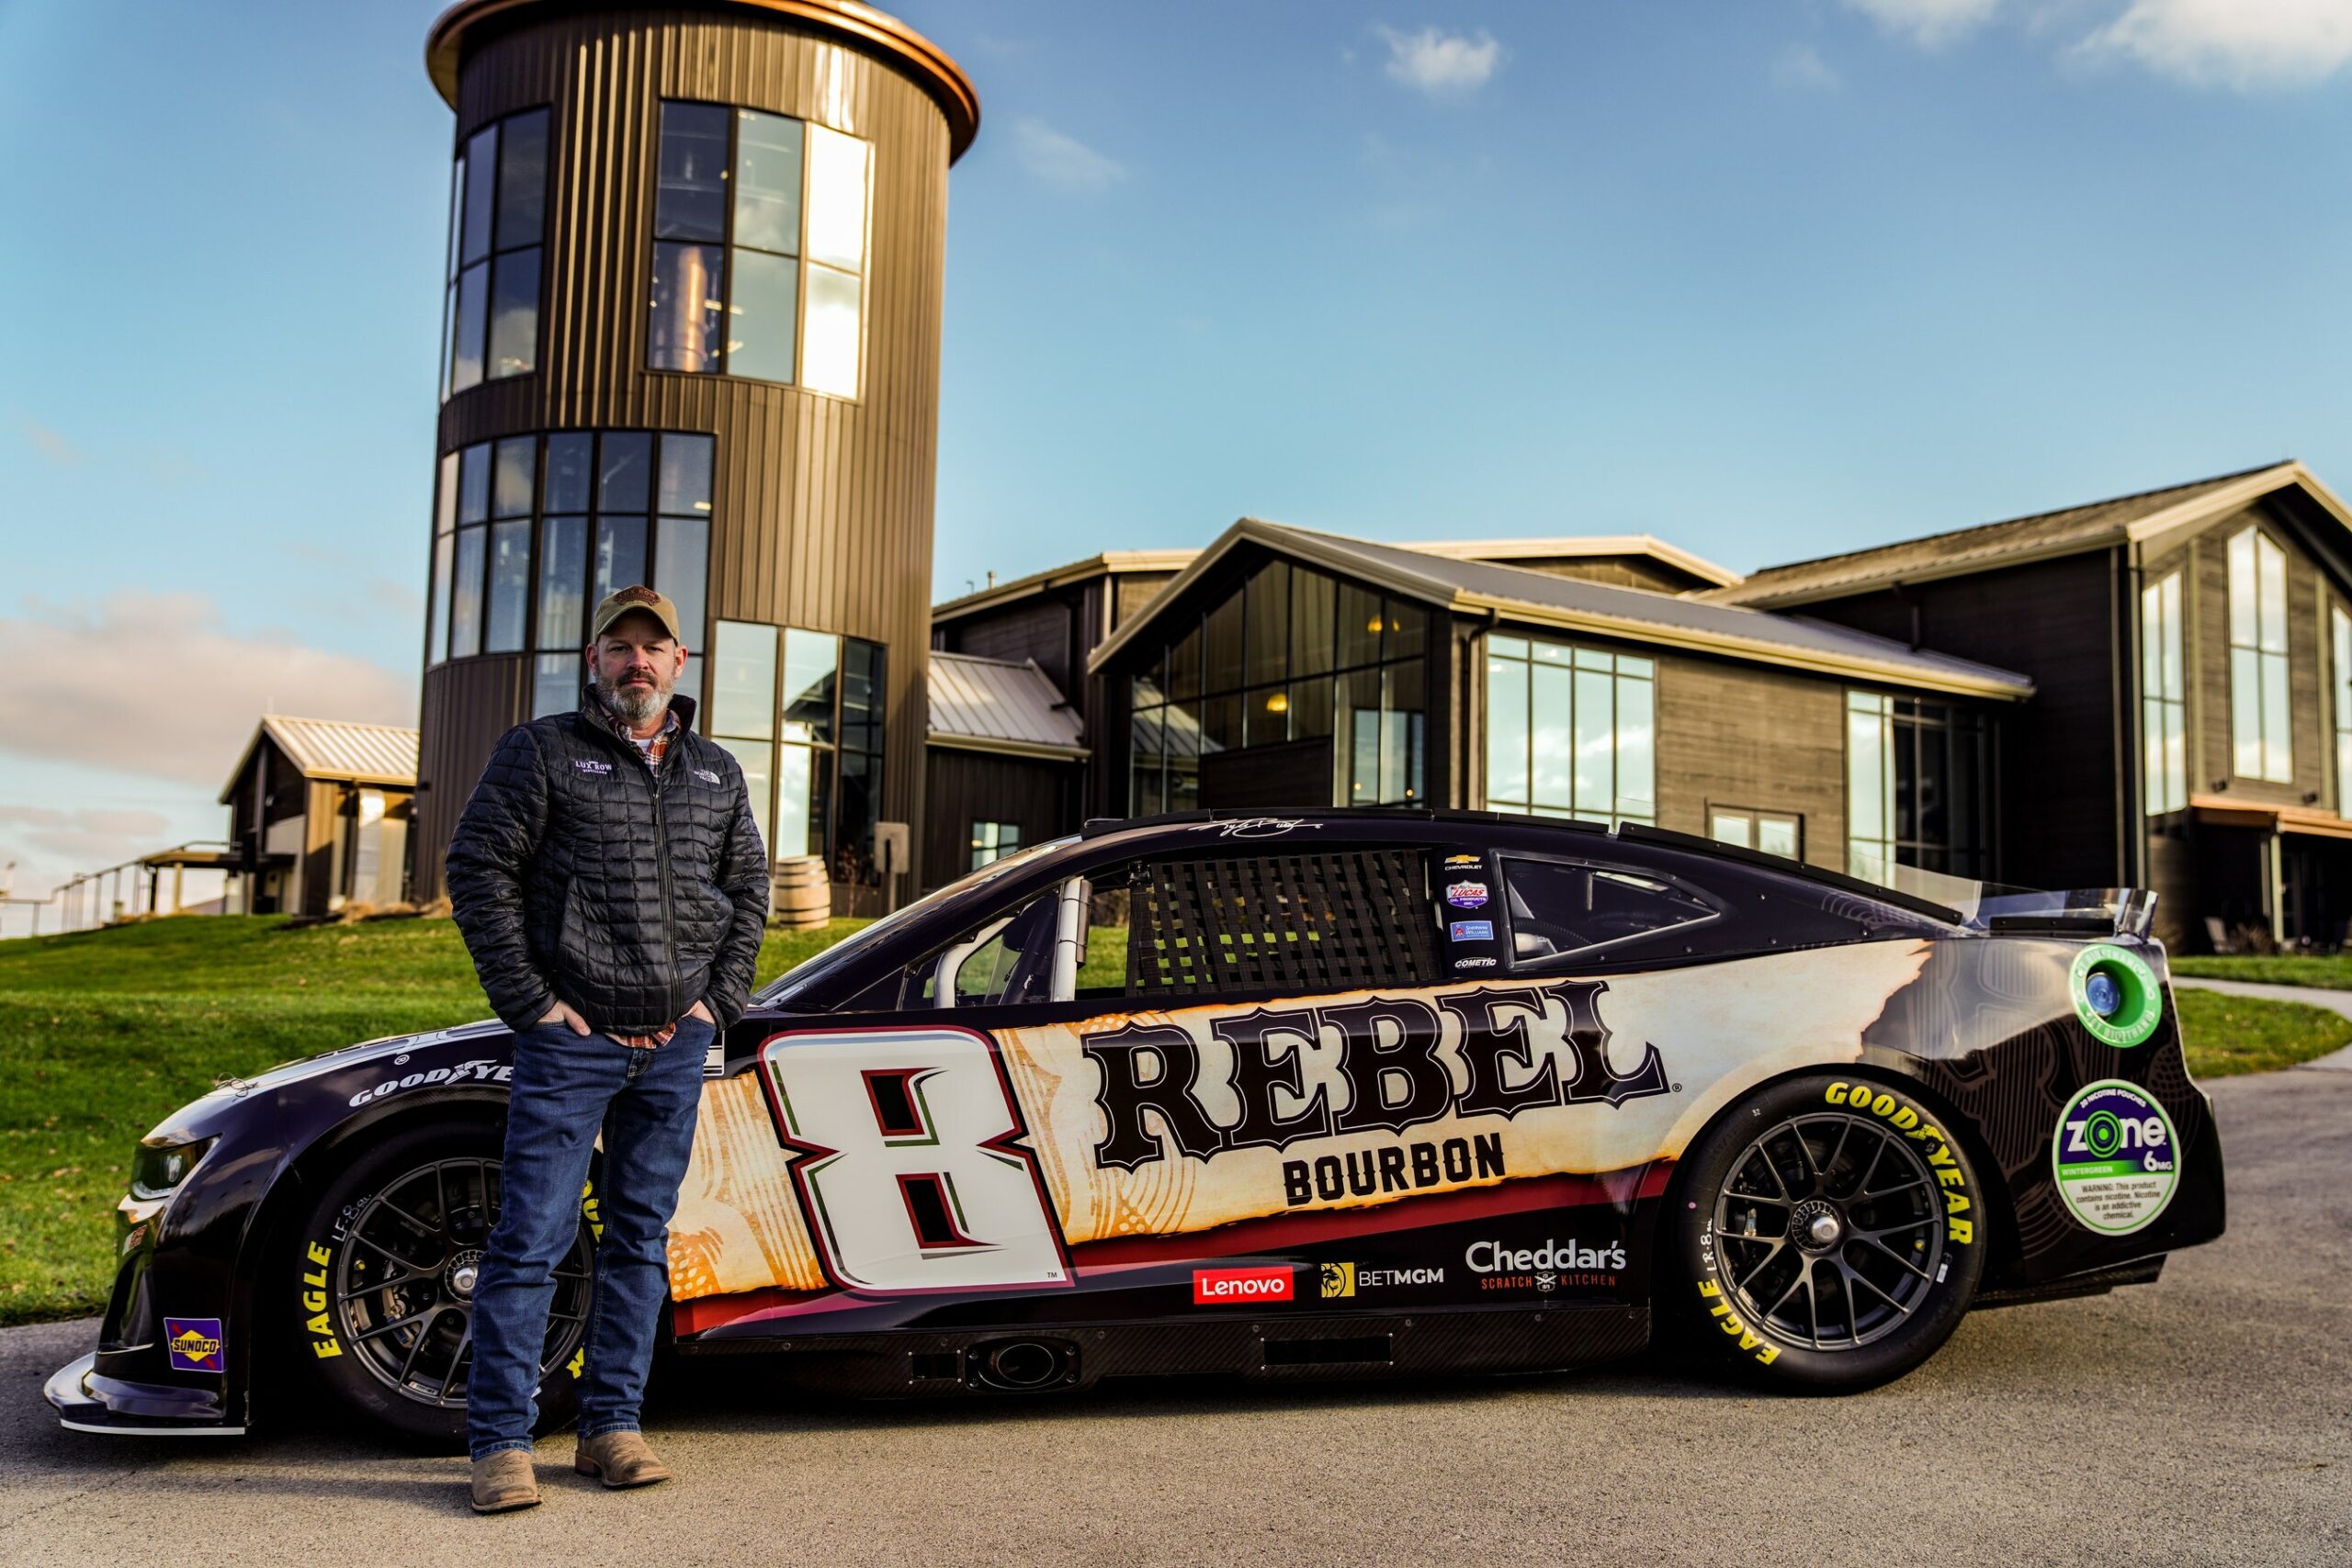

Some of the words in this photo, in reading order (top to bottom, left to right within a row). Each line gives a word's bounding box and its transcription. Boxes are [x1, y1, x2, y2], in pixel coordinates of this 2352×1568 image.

[575, 761, 593, 770] LUX
[1451, 887, 1485, 897] LUCAS
[1454, 957, 1498, 968] COMETIC
[349, 1060, 514, 1108] GOODYE
[1080, 979, 1671, 1175] REBEL
[2066, 1111, 2166, 1158] zone
[763, 1025, 1075, 1295] 8
[1825, 1081, 1973, 1246] GOODYEAR
[1283, 1132, 1506, 1208] BOURBON
[2061, 1165, 2113, 1177] WINTERGREEN
[2116, 1182, 2130, 1190] This
[2131, 1181, 2156, 1190] product
[2075, 1194, 2103, 1203] contains
[2111, 1201, 2142, 1210] addictive
[2103, 1212, 2134, 1220] chemical.
[1465, 1238, 1626, 1273] Cheddar's
[1359, 1268, 1444, 1286] BETMGM
[1481, 1276, 1532, 1290] SCRATCH
[1561, 1273, 1616, 1287] KITCHEN
[1202, 1278, 1284, 1296] Lenovo
[302, 1240, 344, 1359] EAGLE
[1697, 1278, 1782, 1366] EAGLE
[174, 1338, 219, 1353] SUNOCO
